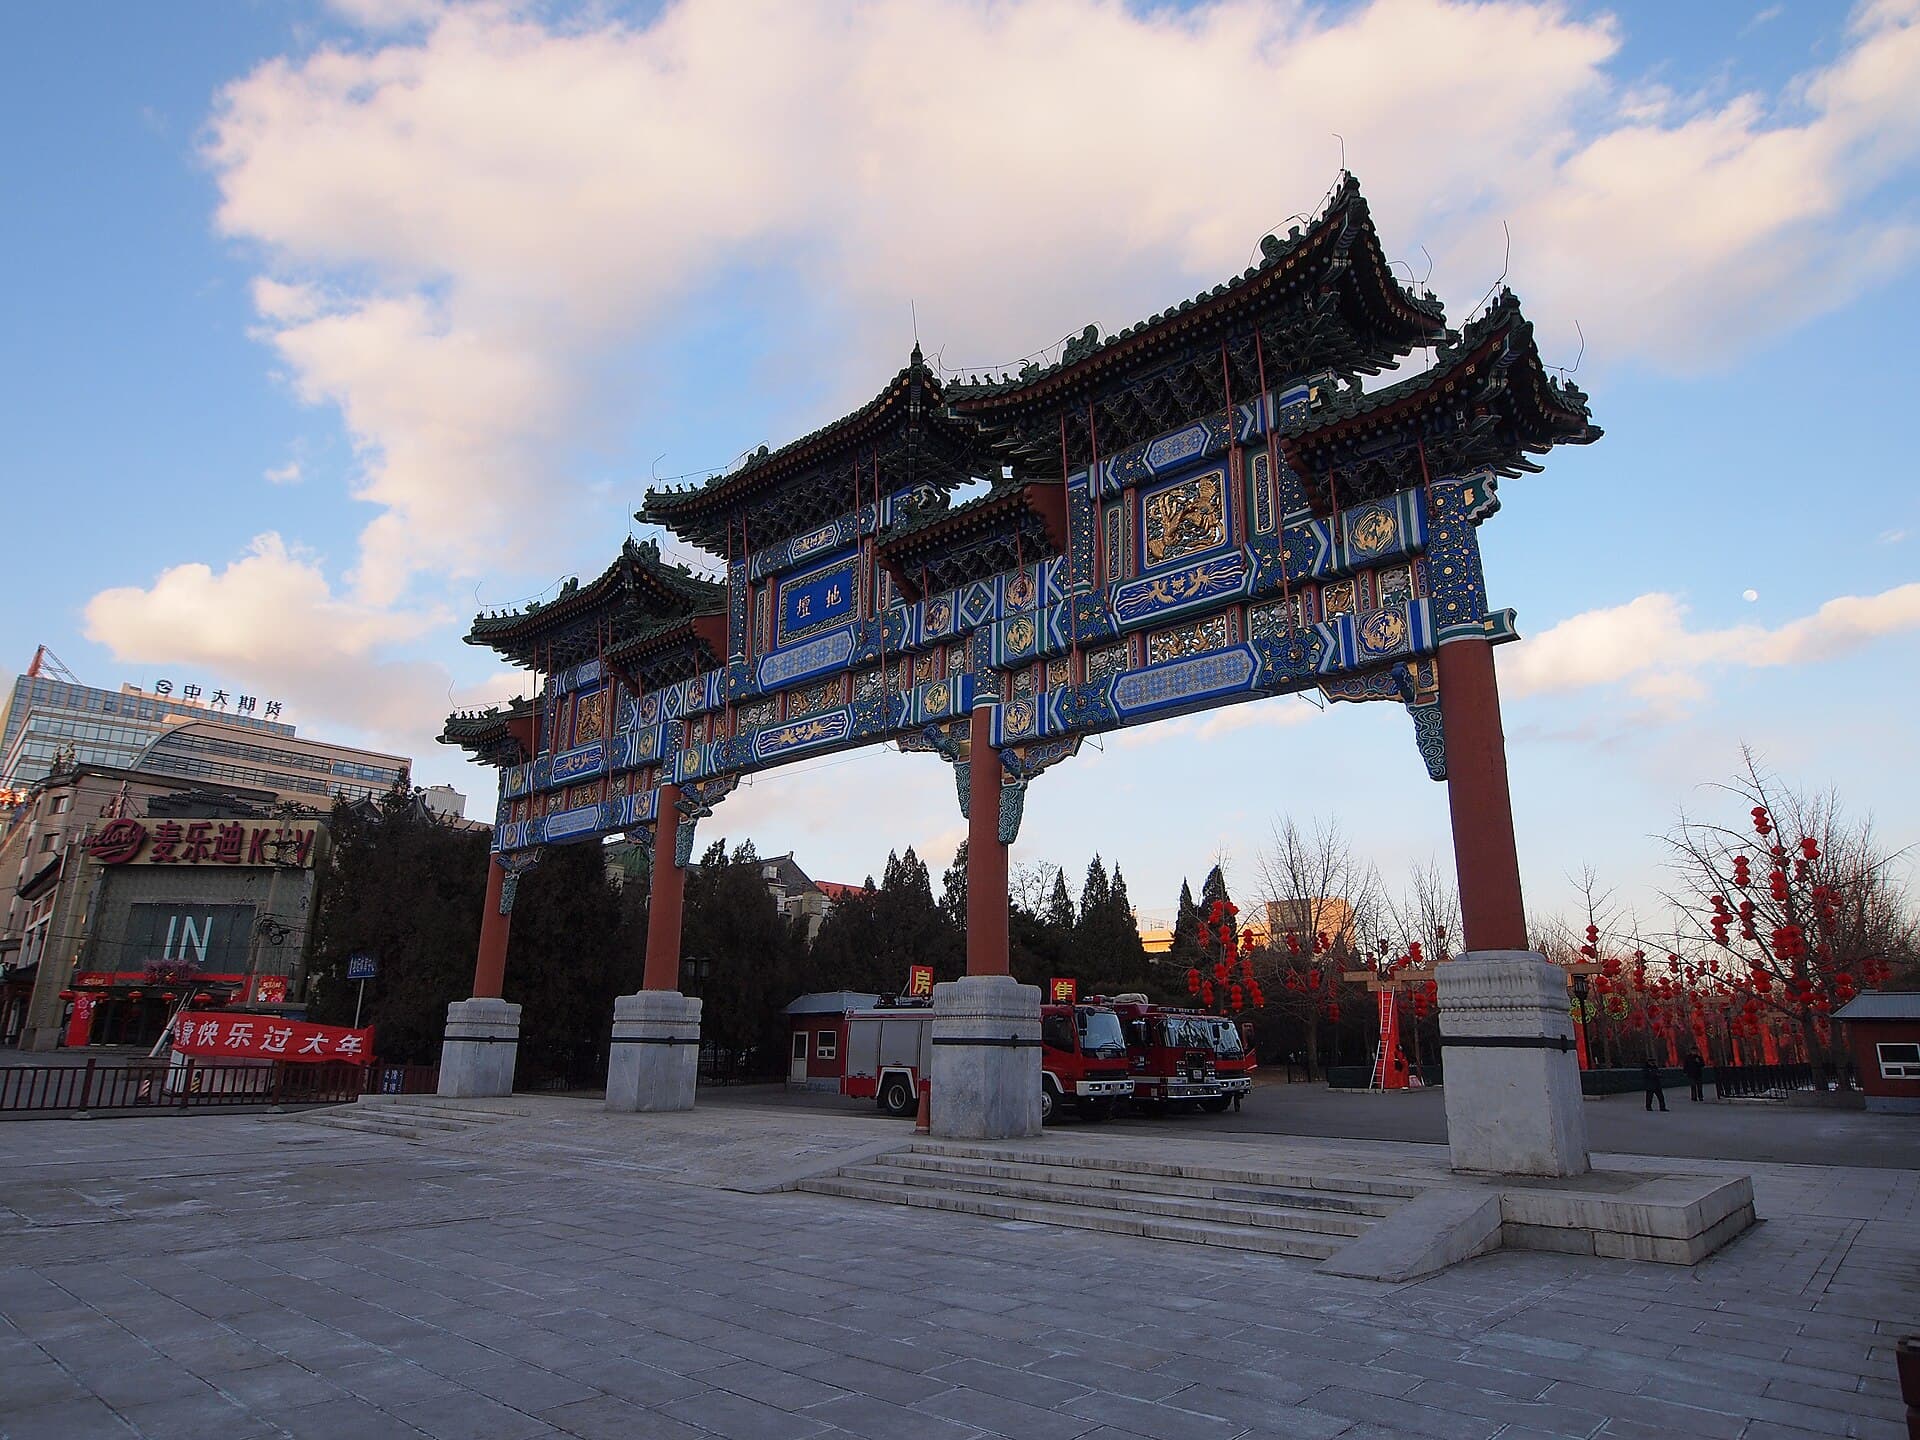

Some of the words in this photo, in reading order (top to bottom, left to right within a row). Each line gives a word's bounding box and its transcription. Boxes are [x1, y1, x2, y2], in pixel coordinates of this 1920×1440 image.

[183, 684, 282, 717] 中大期货
[163, 915, 213, 961] IN
[913, 970, 930, 994] 房
